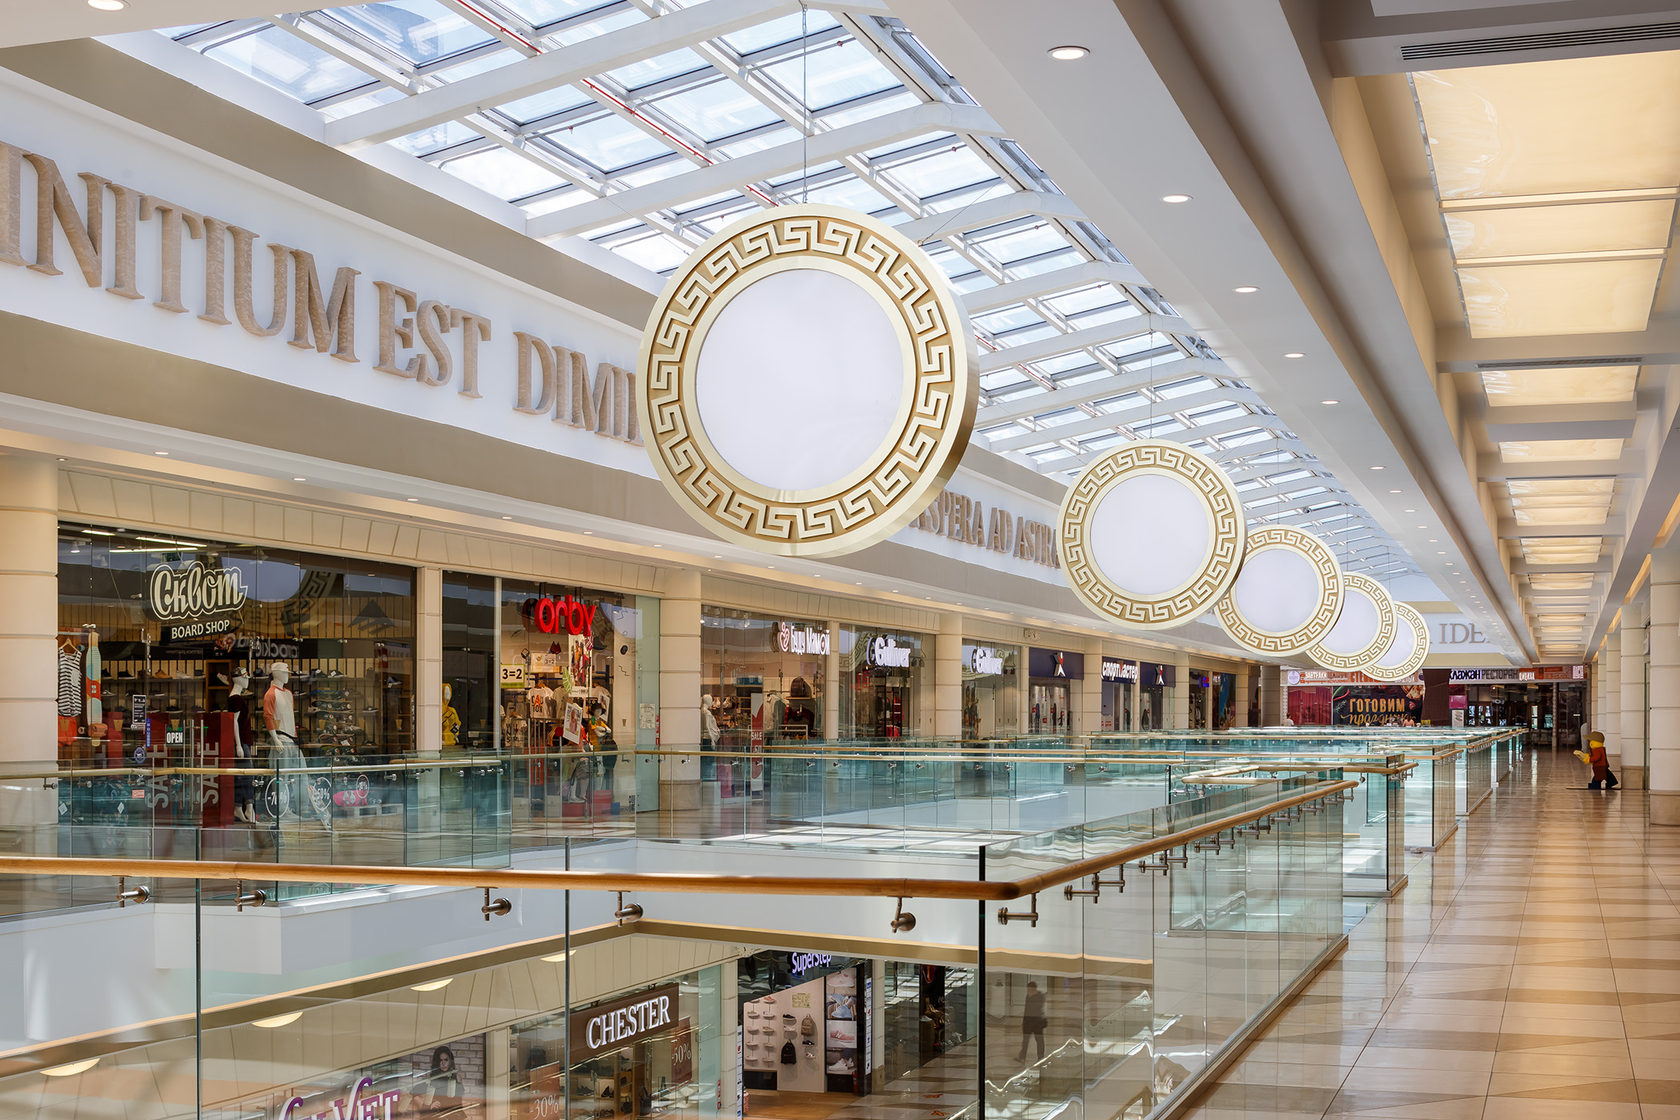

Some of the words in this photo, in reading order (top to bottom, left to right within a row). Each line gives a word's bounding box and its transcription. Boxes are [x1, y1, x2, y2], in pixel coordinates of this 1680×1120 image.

[0, 140, 362, 364] INITIUM
[372, 280, 492, 399] EST
[986, 507, 1014, 554] AD
[534, 595, 597, 637] orby
[171, 622, 204, 640] BOARD
[205, 619, 231, 635] SHOP
[1439, 622, 1491, 645] IDE
[501, 668, 523, 680] 3=2
[1349, 698, 1406, 713] ГОТОВИМ
[166, 731, 184, 745] OPEN
[586, 995, 671, 1049] CHESTER
